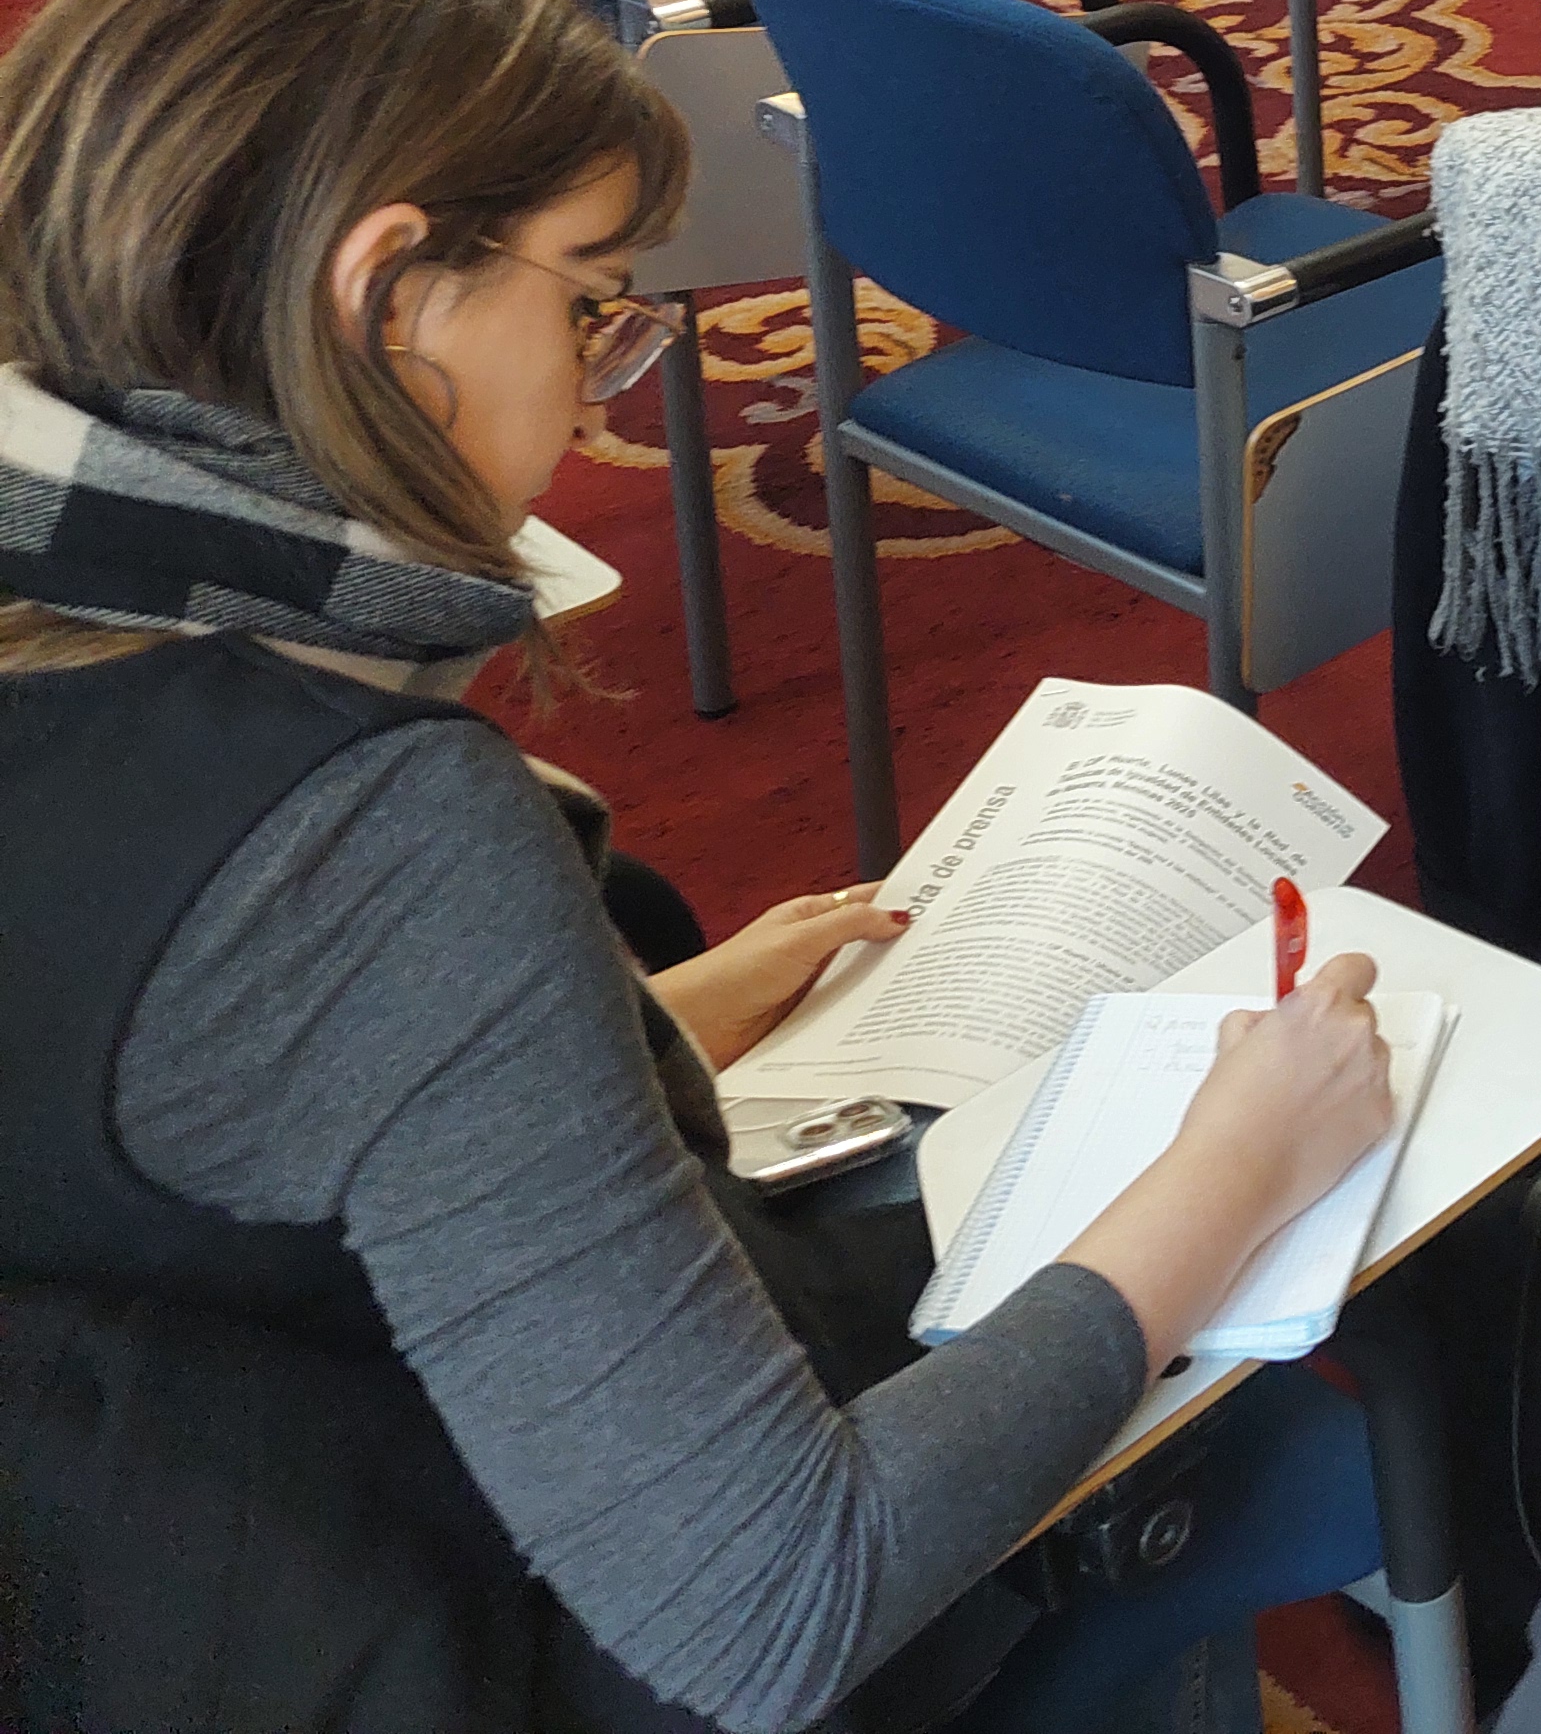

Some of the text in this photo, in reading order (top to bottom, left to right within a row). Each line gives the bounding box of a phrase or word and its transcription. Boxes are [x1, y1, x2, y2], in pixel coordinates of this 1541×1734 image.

[906, 785, 1018, 923] ota de prensa
